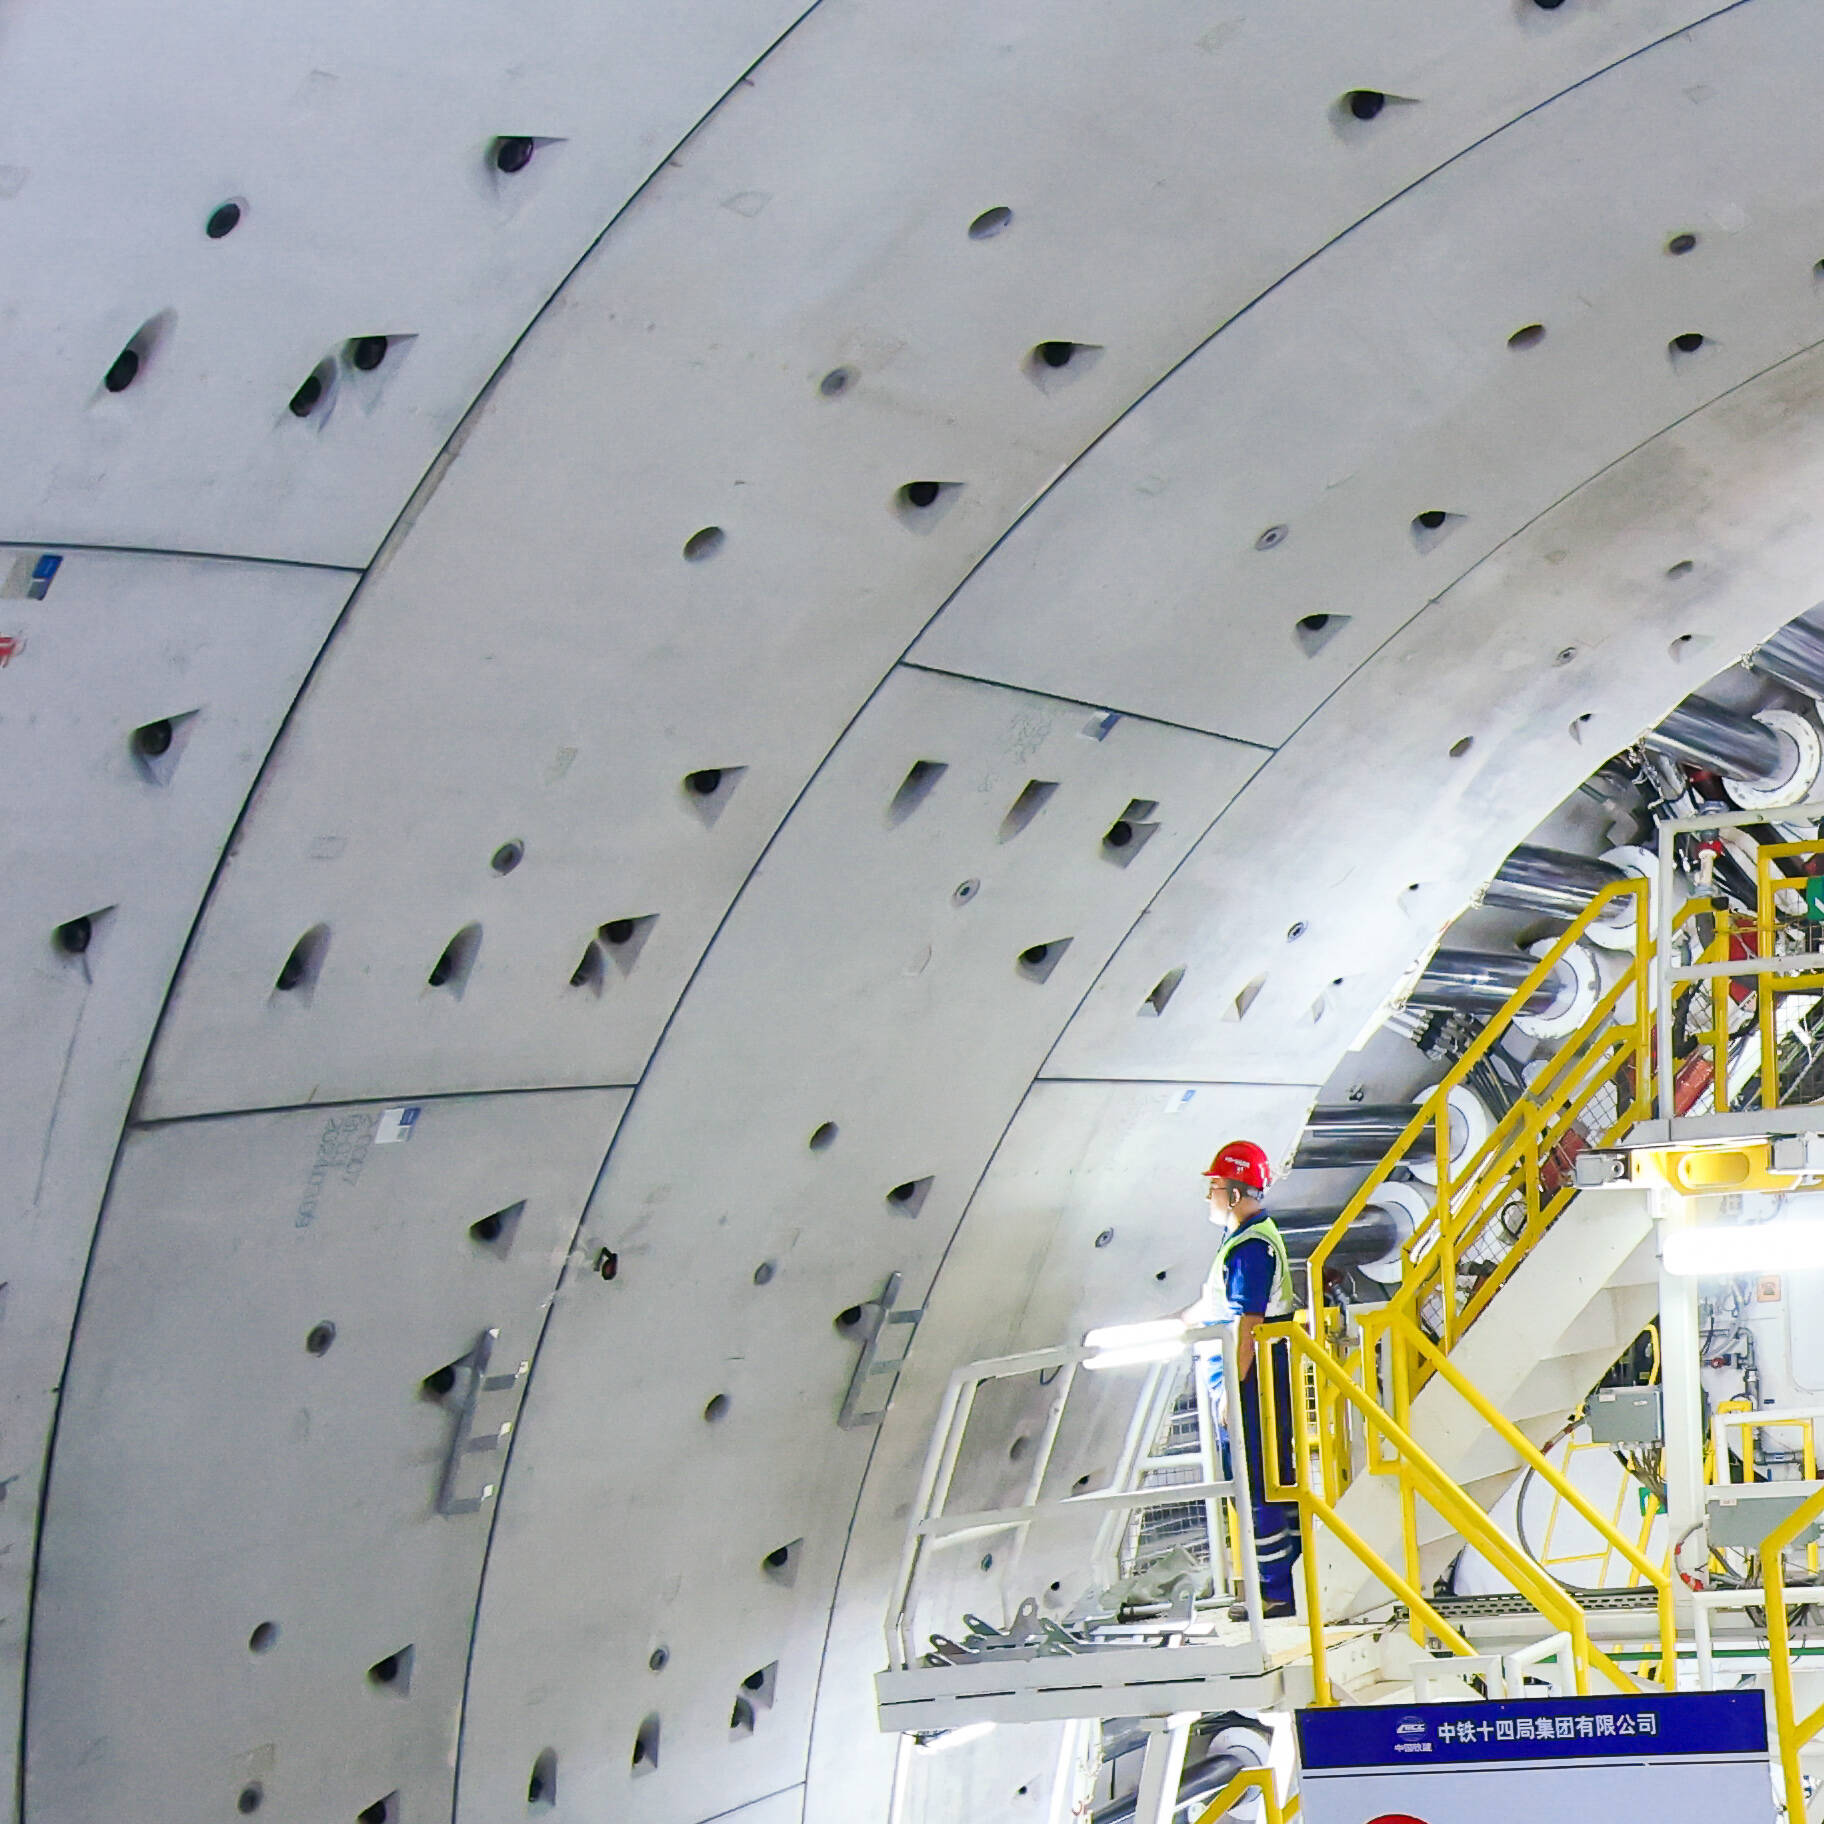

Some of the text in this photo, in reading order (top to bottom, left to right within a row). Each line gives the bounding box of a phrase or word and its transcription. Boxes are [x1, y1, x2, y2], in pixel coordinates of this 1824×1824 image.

[1437, 1713, 1658, 1744] 中铁十四局集团有限公司
